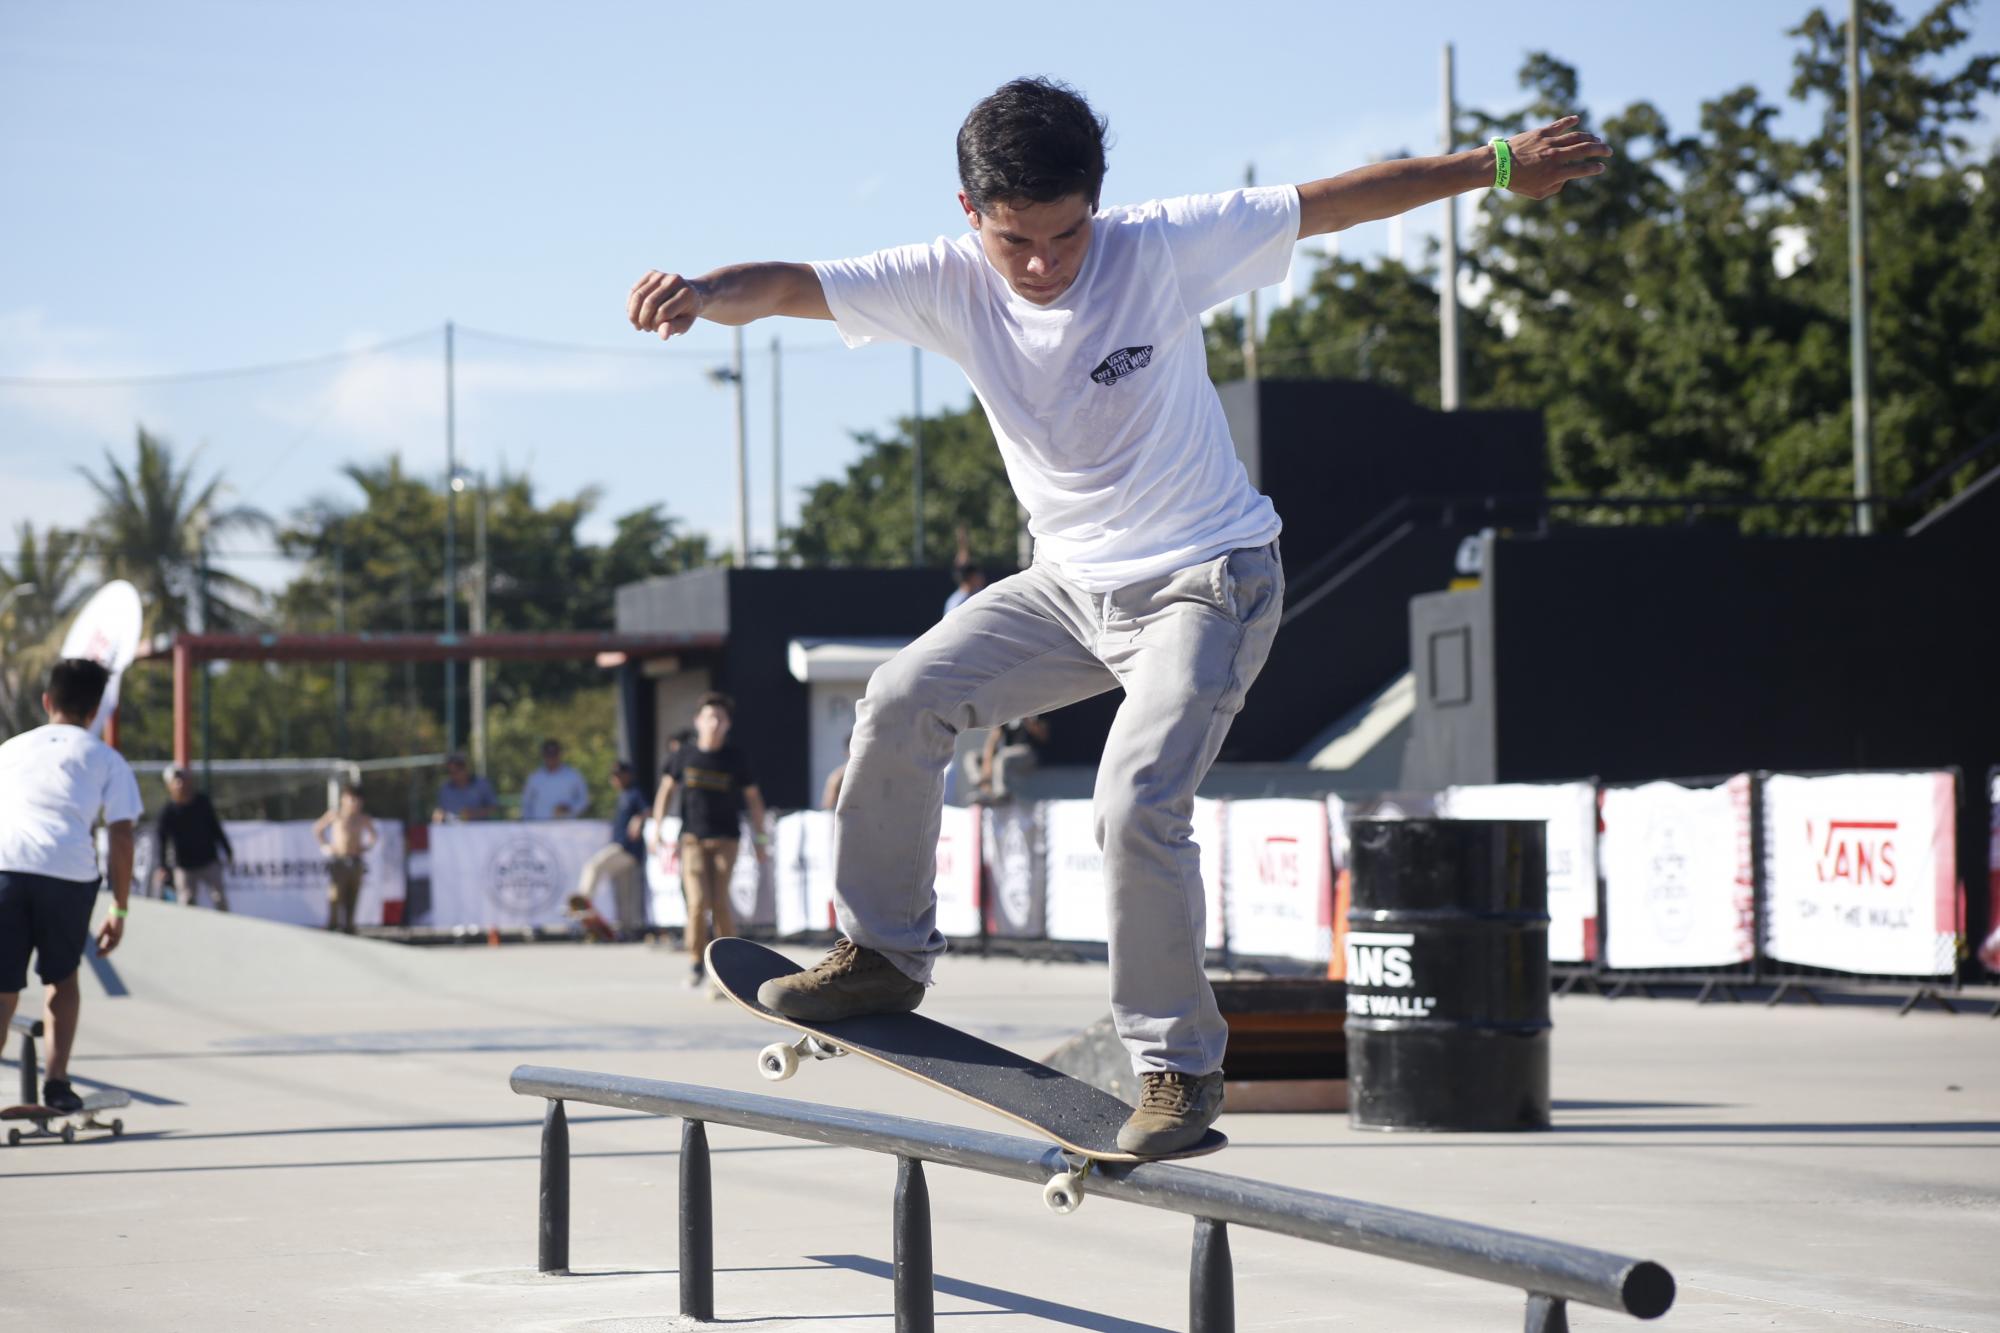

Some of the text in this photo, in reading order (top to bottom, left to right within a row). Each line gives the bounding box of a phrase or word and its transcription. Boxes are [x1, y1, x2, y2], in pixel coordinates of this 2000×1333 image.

[1106, 349, 1130, 367] VANS
[1112, 362, 1131, 376] THE
[1345, 932, 1416, 988] ANS
